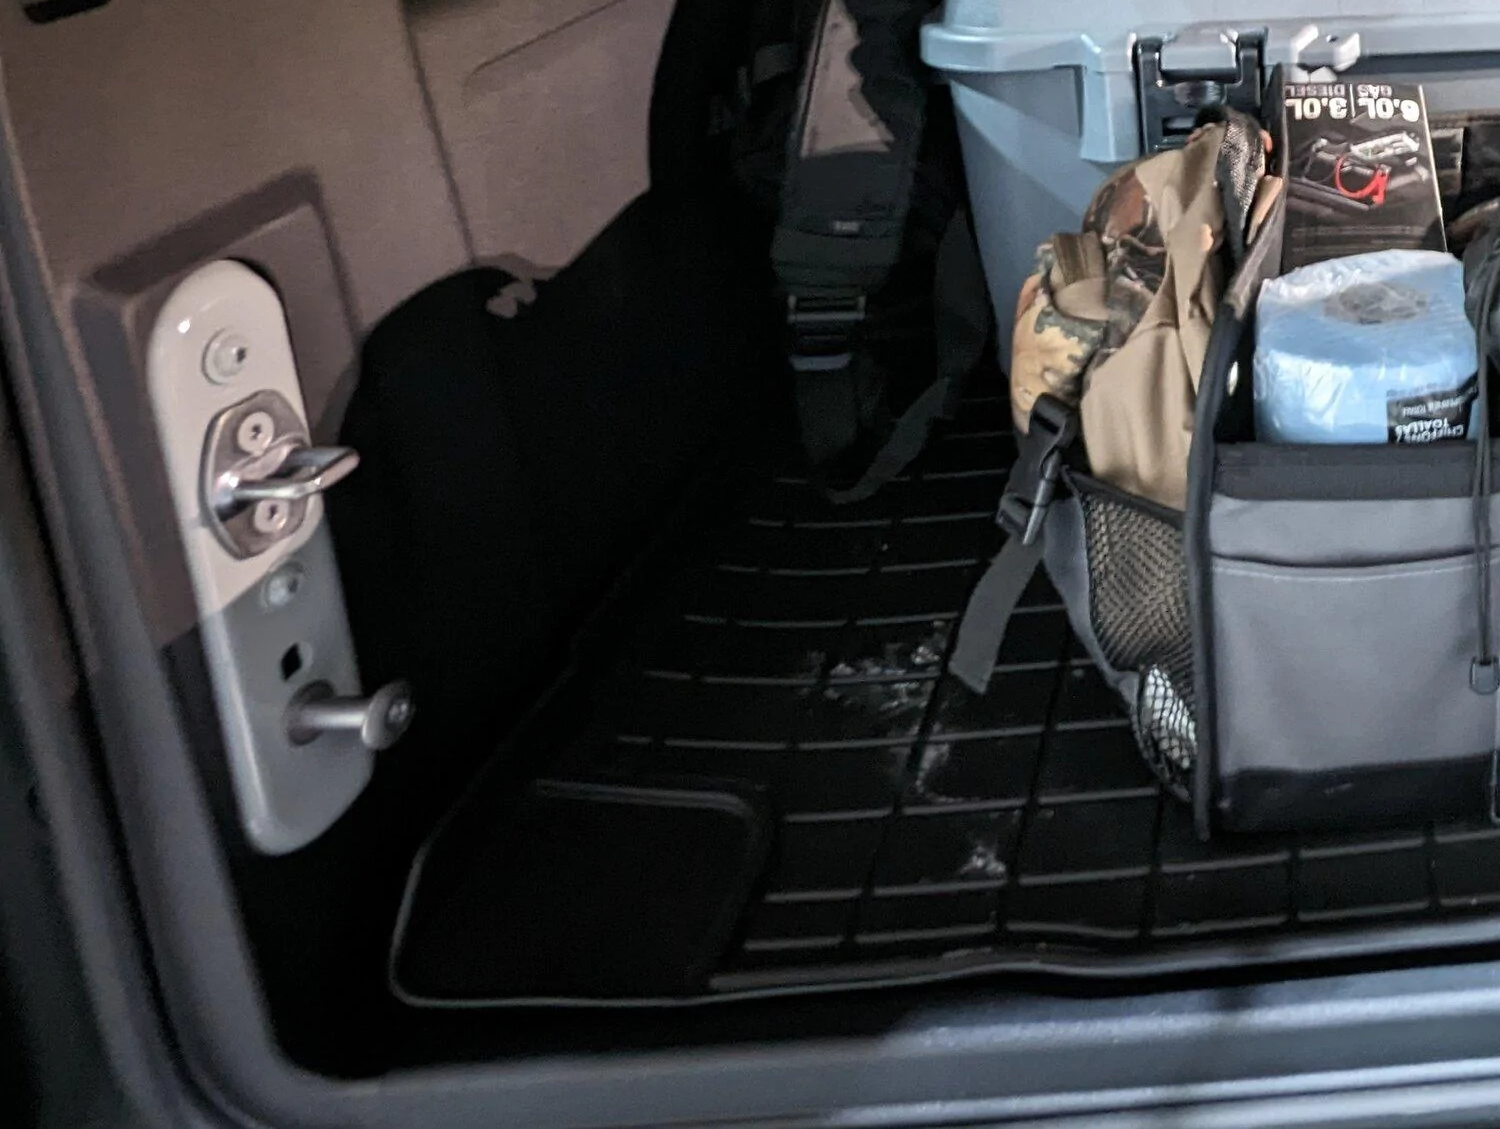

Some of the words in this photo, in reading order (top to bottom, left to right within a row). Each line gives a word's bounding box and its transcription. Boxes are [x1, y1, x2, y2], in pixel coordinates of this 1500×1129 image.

[1284, 83, 1346, 97] DIESEL
[1357, 84, 1393, 98] GAS
[1284, 97, 1347, 120] 3.0L
[1357, 98, 1421, 122] 6.0L
